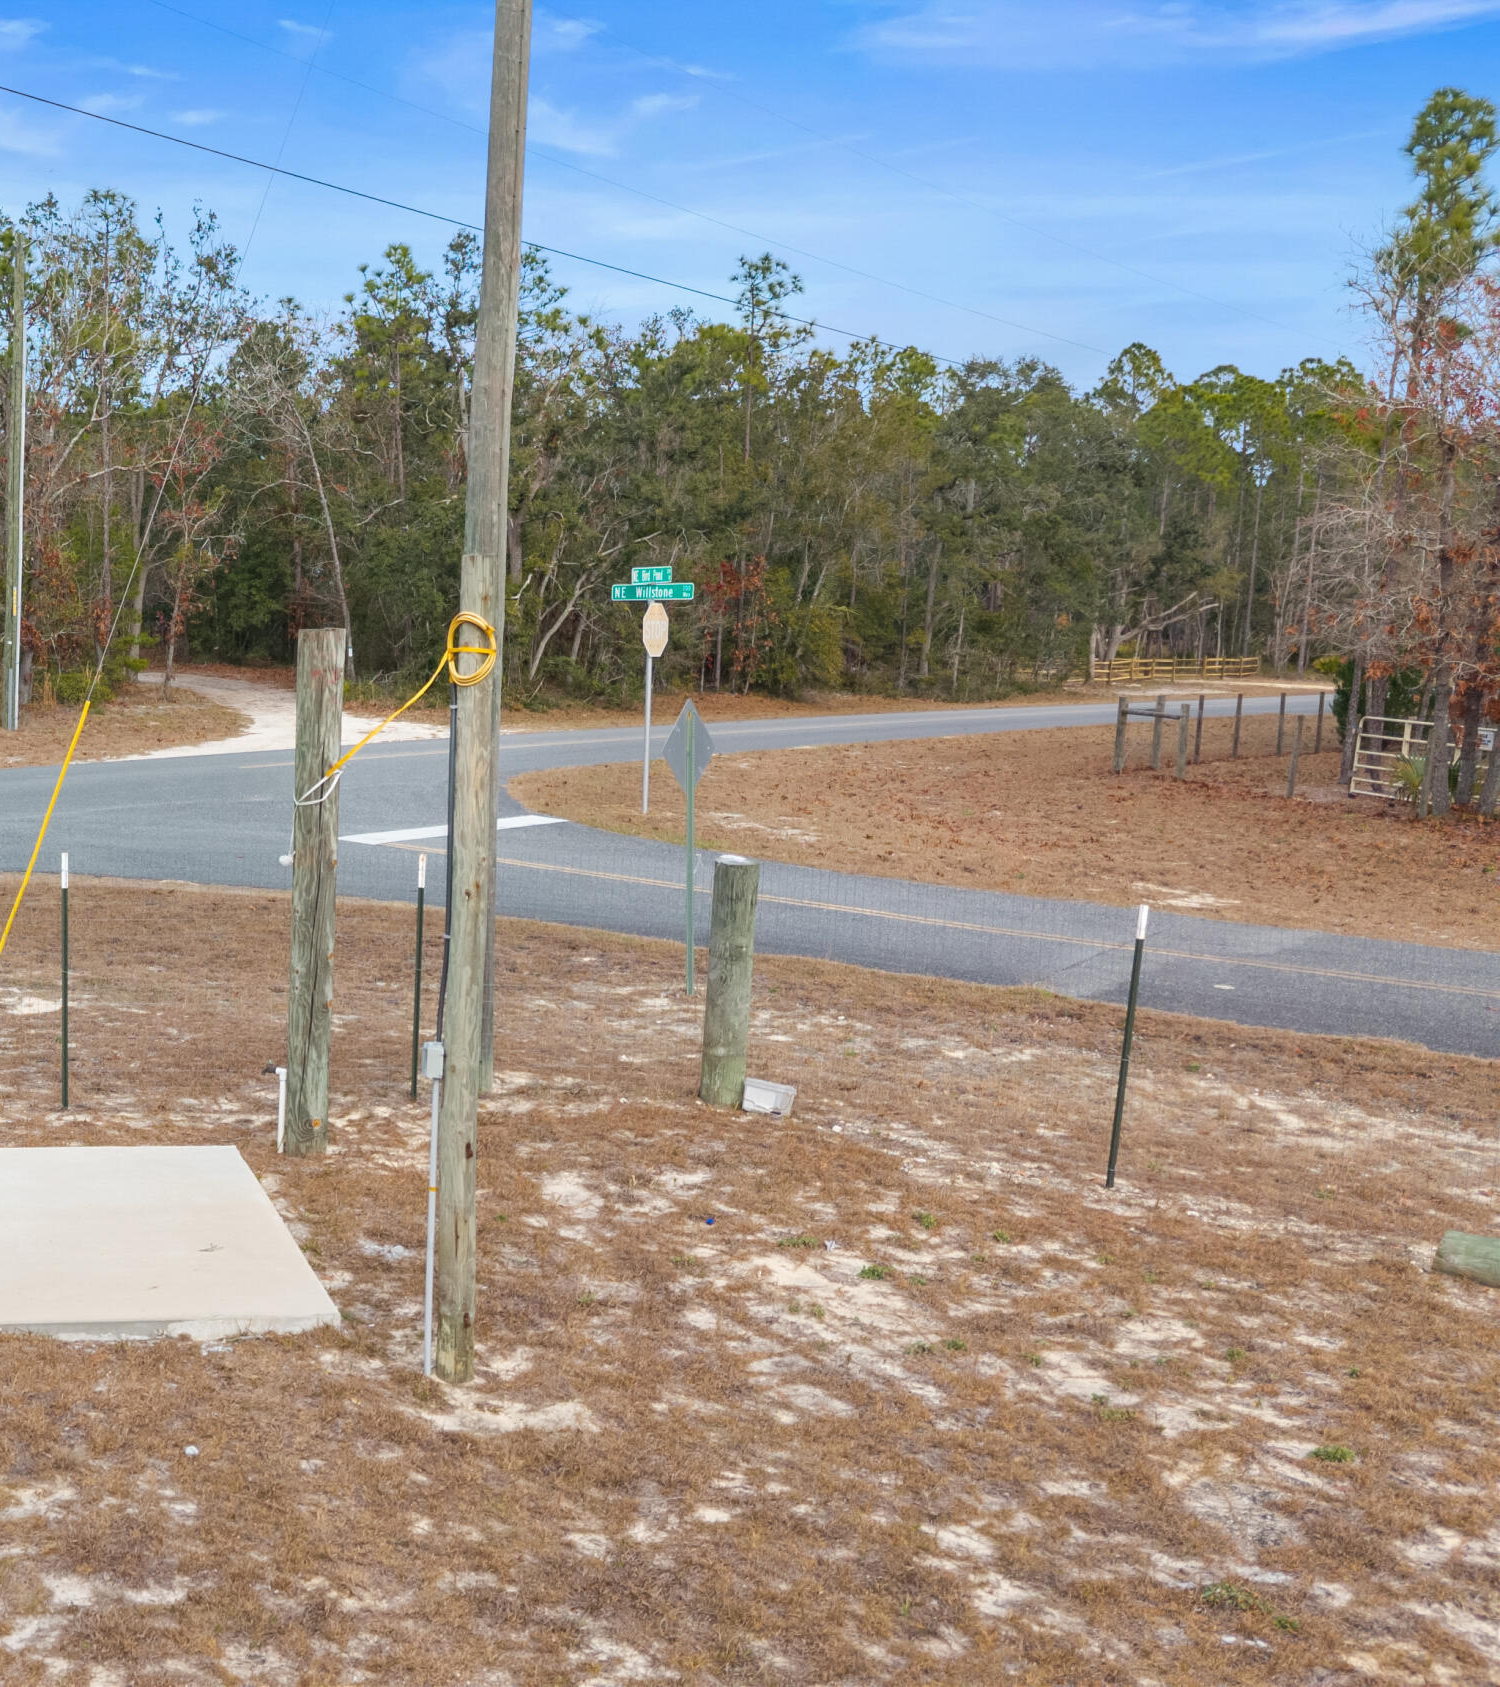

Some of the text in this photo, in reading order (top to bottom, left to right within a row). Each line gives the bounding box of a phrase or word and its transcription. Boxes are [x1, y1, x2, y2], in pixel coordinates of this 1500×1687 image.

[614, 586, 674, 598] NE Willstone
[646, 620, 667, 640] STOP
